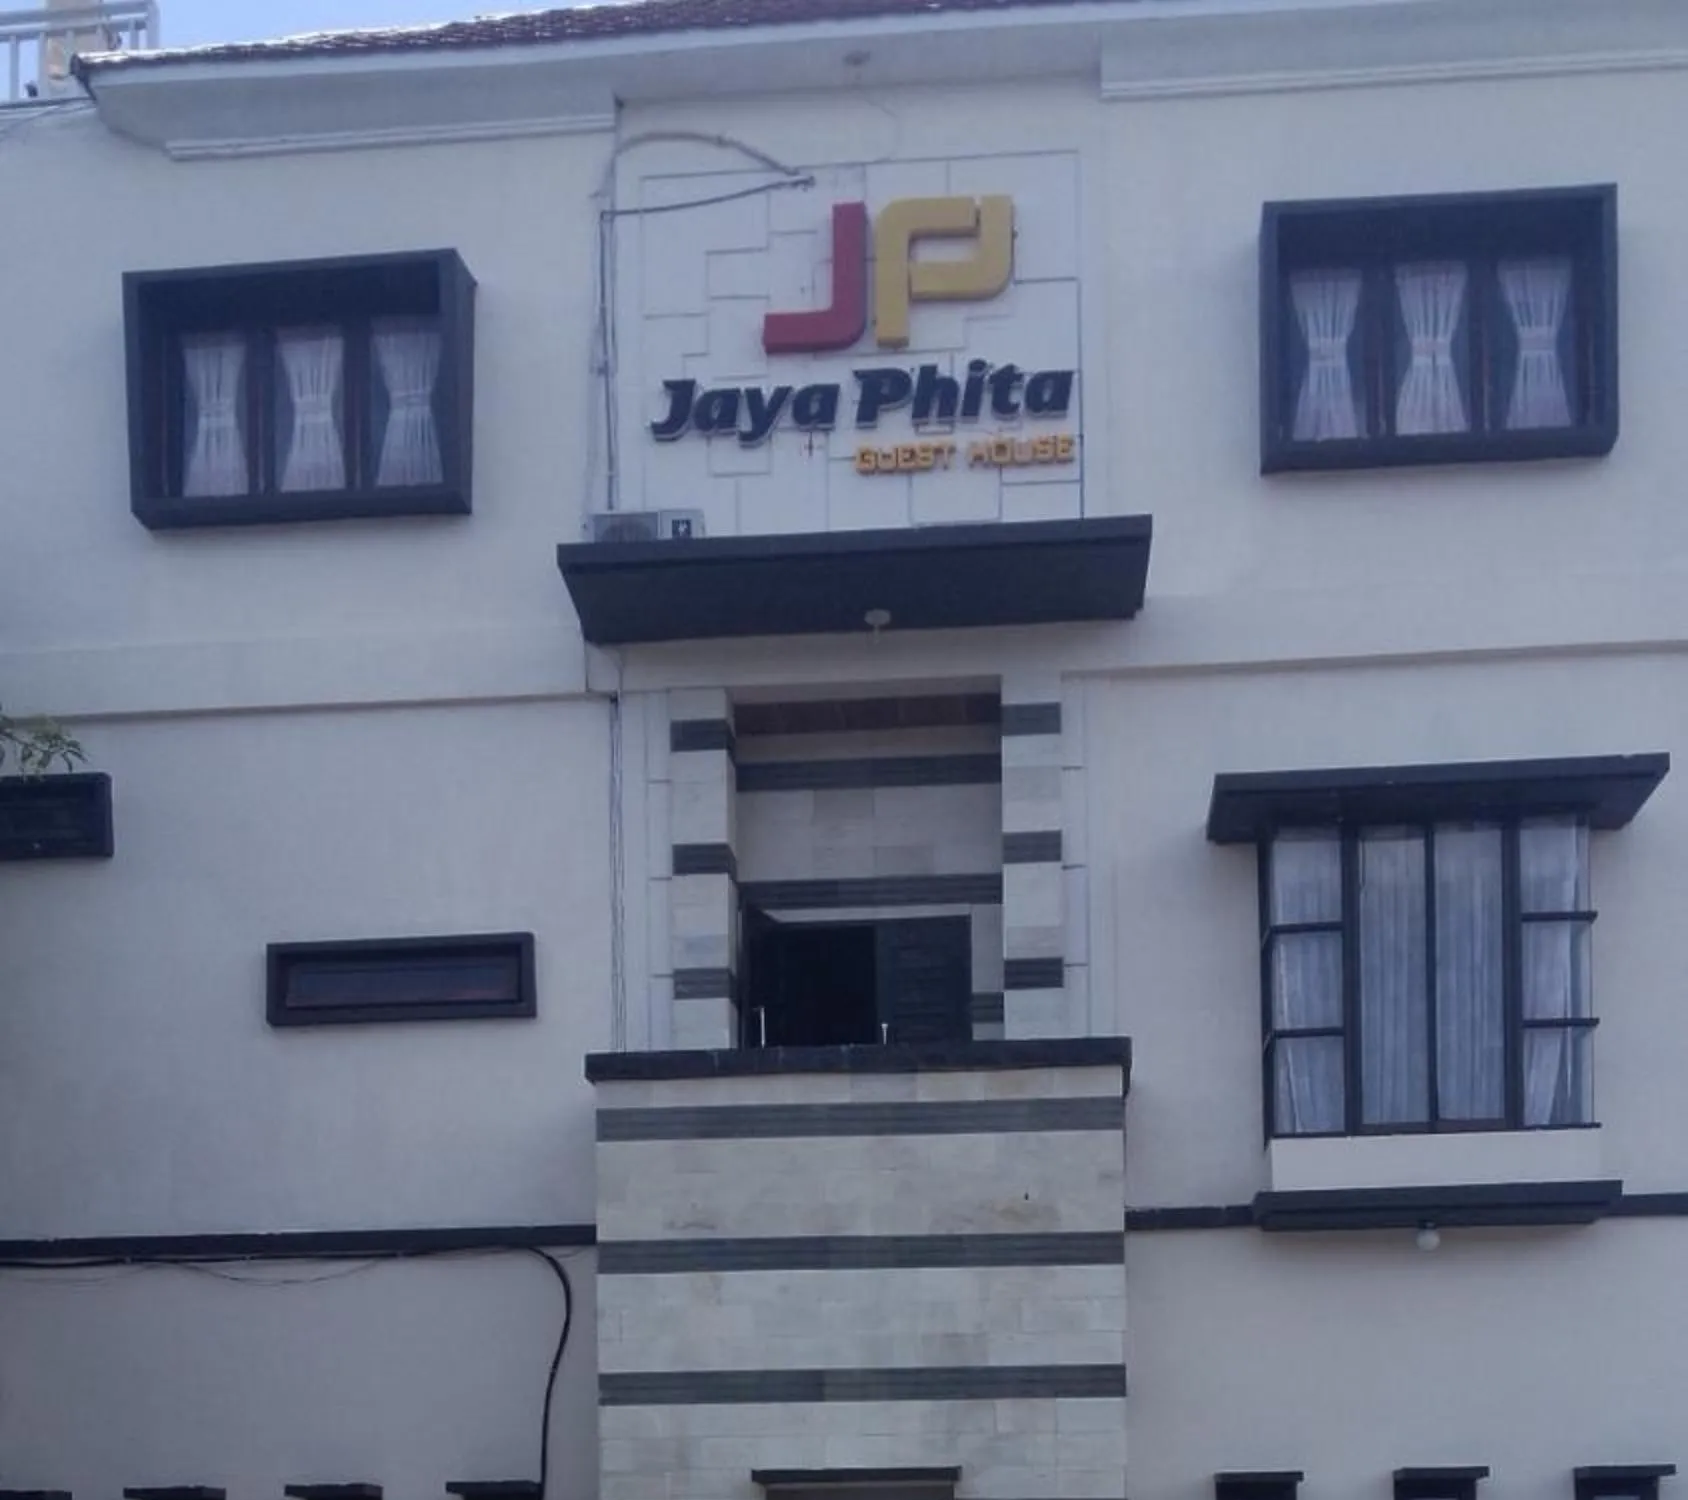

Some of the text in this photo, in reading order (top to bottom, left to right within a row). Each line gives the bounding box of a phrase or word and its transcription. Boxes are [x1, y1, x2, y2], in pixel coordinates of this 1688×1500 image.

[650, 358, 1074, 447] Jaya Phita
[856, 434, 1076, 474] GUEST HOUSE
